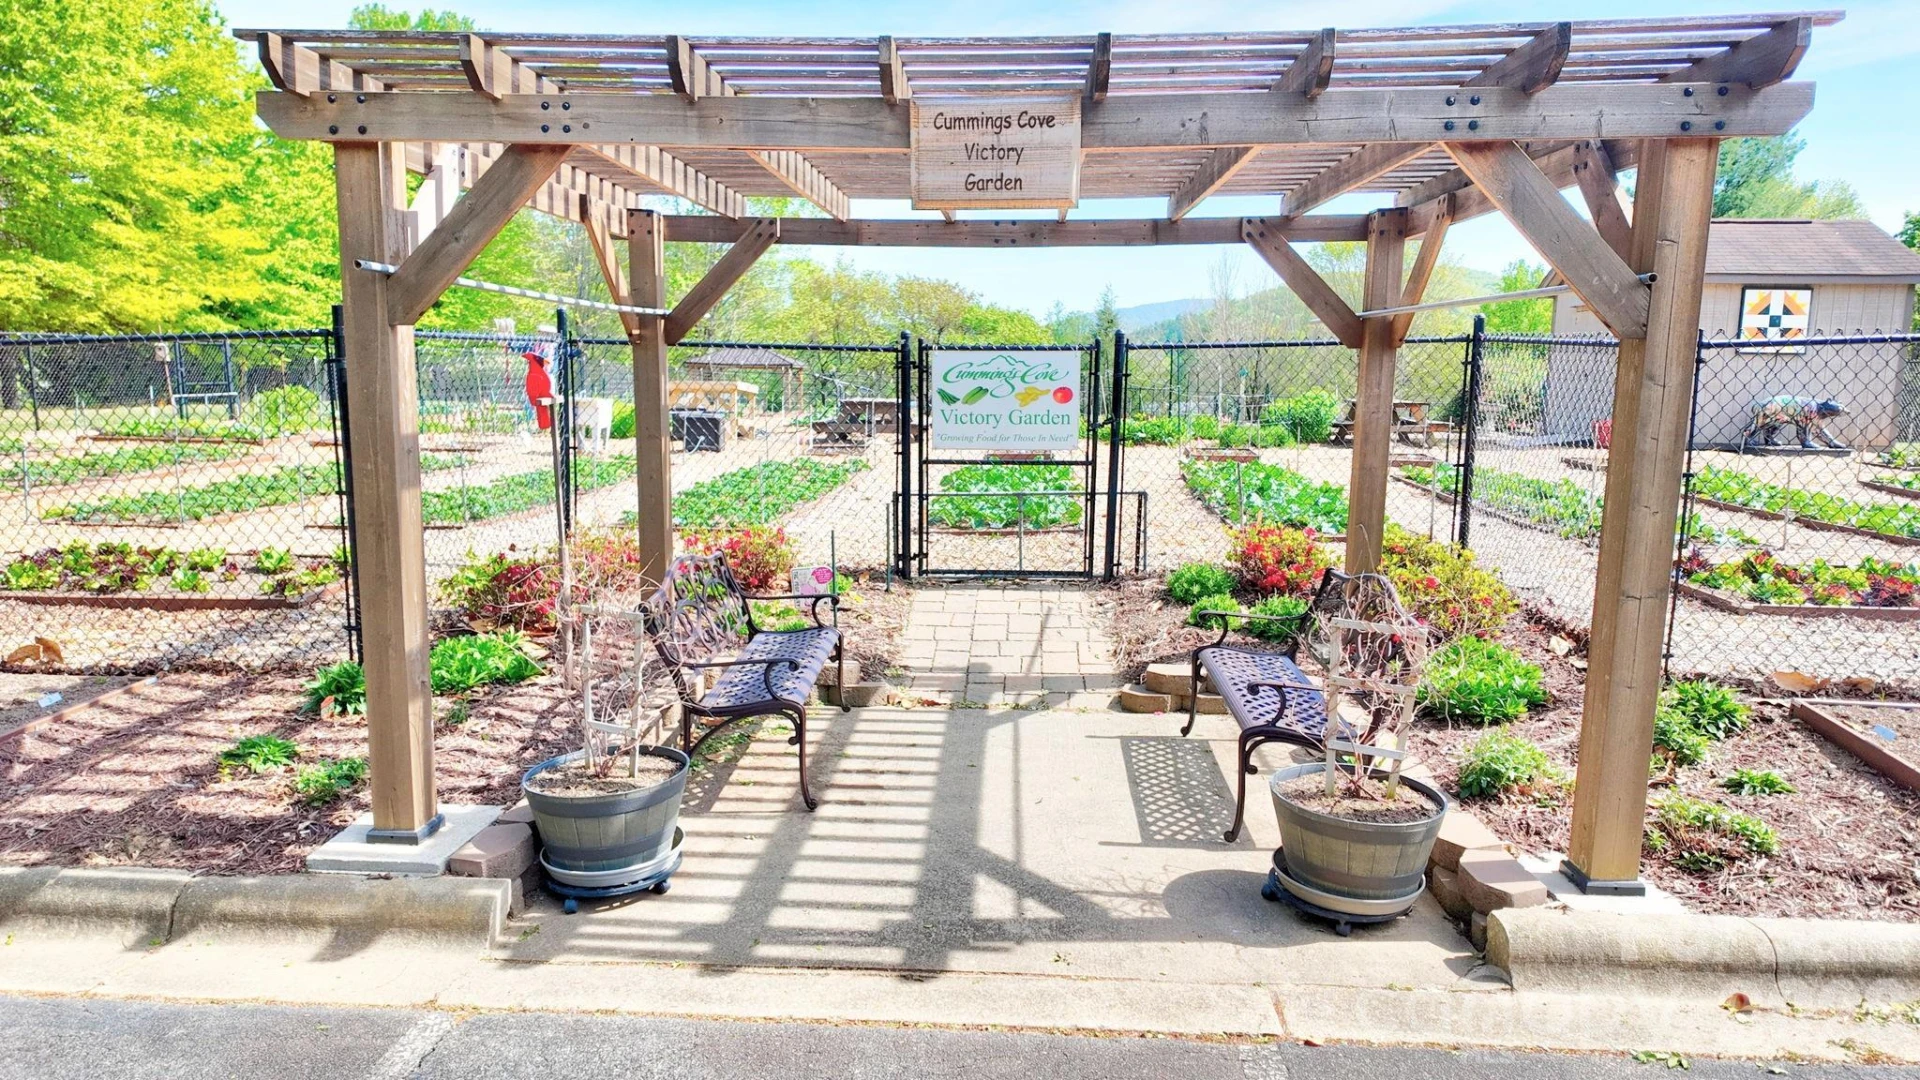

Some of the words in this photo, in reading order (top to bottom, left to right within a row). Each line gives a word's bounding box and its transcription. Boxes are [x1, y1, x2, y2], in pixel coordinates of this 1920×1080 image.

[933, 112, 1012, 135] Cummings
[1017, 111, 1056, 128] Cove
[964, 142, 1024, 165] Victory
[964, 172, 1023, 191] Garden
[1020, 362, 1070, 384] Cove
[940, 409, 1002, 429] Victory
[1008, 409, 1071, 426] Garden
[937, 433, 974, 443] "Growing
[976, 433, 997, 442] Food
[998, 433, 1010, 443] for
[1013, 433, 1035, 442] Those
[1038, 434, 1047, 442] In
[1049, 433, 1074, 442] Need"
